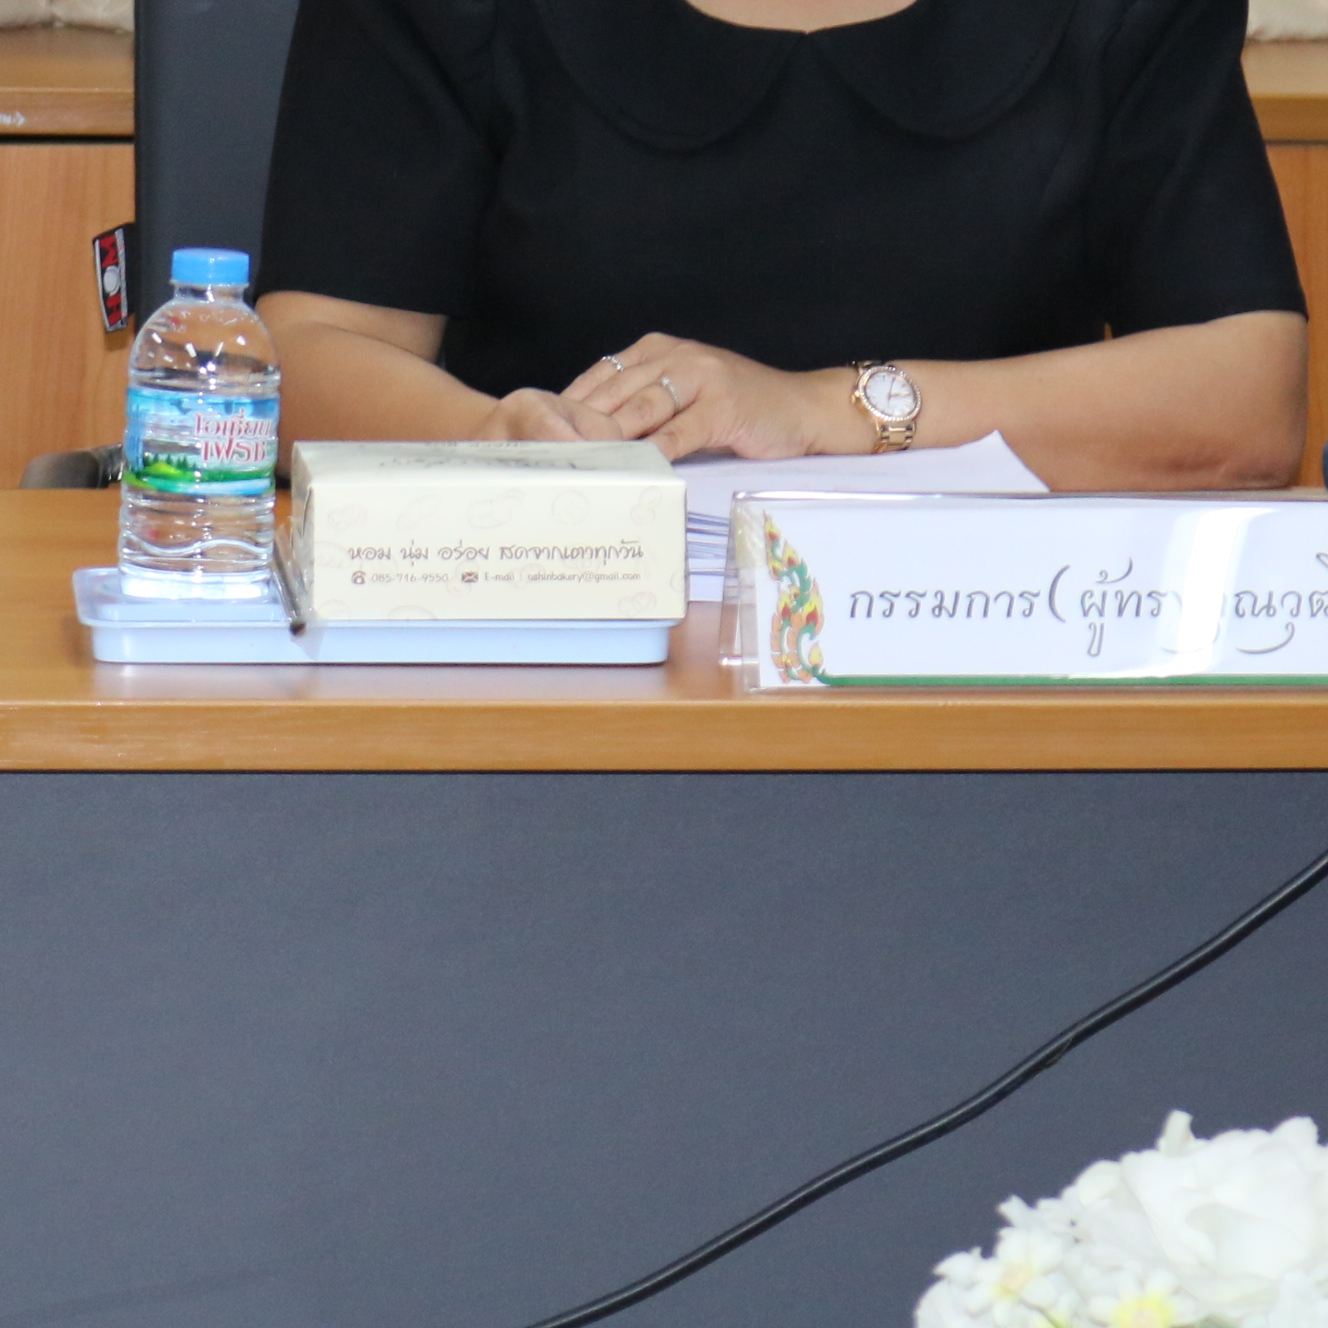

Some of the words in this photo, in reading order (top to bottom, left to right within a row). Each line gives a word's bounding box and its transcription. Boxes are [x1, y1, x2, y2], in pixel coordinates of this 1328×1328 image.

[348, 546, 392, 561] หอม
[400, 539, 429, 566] นุ่ม
[437, 539, 491, 561] อร่อย
[499, 539, 645, 566] สดจากเตาทุกวัน
